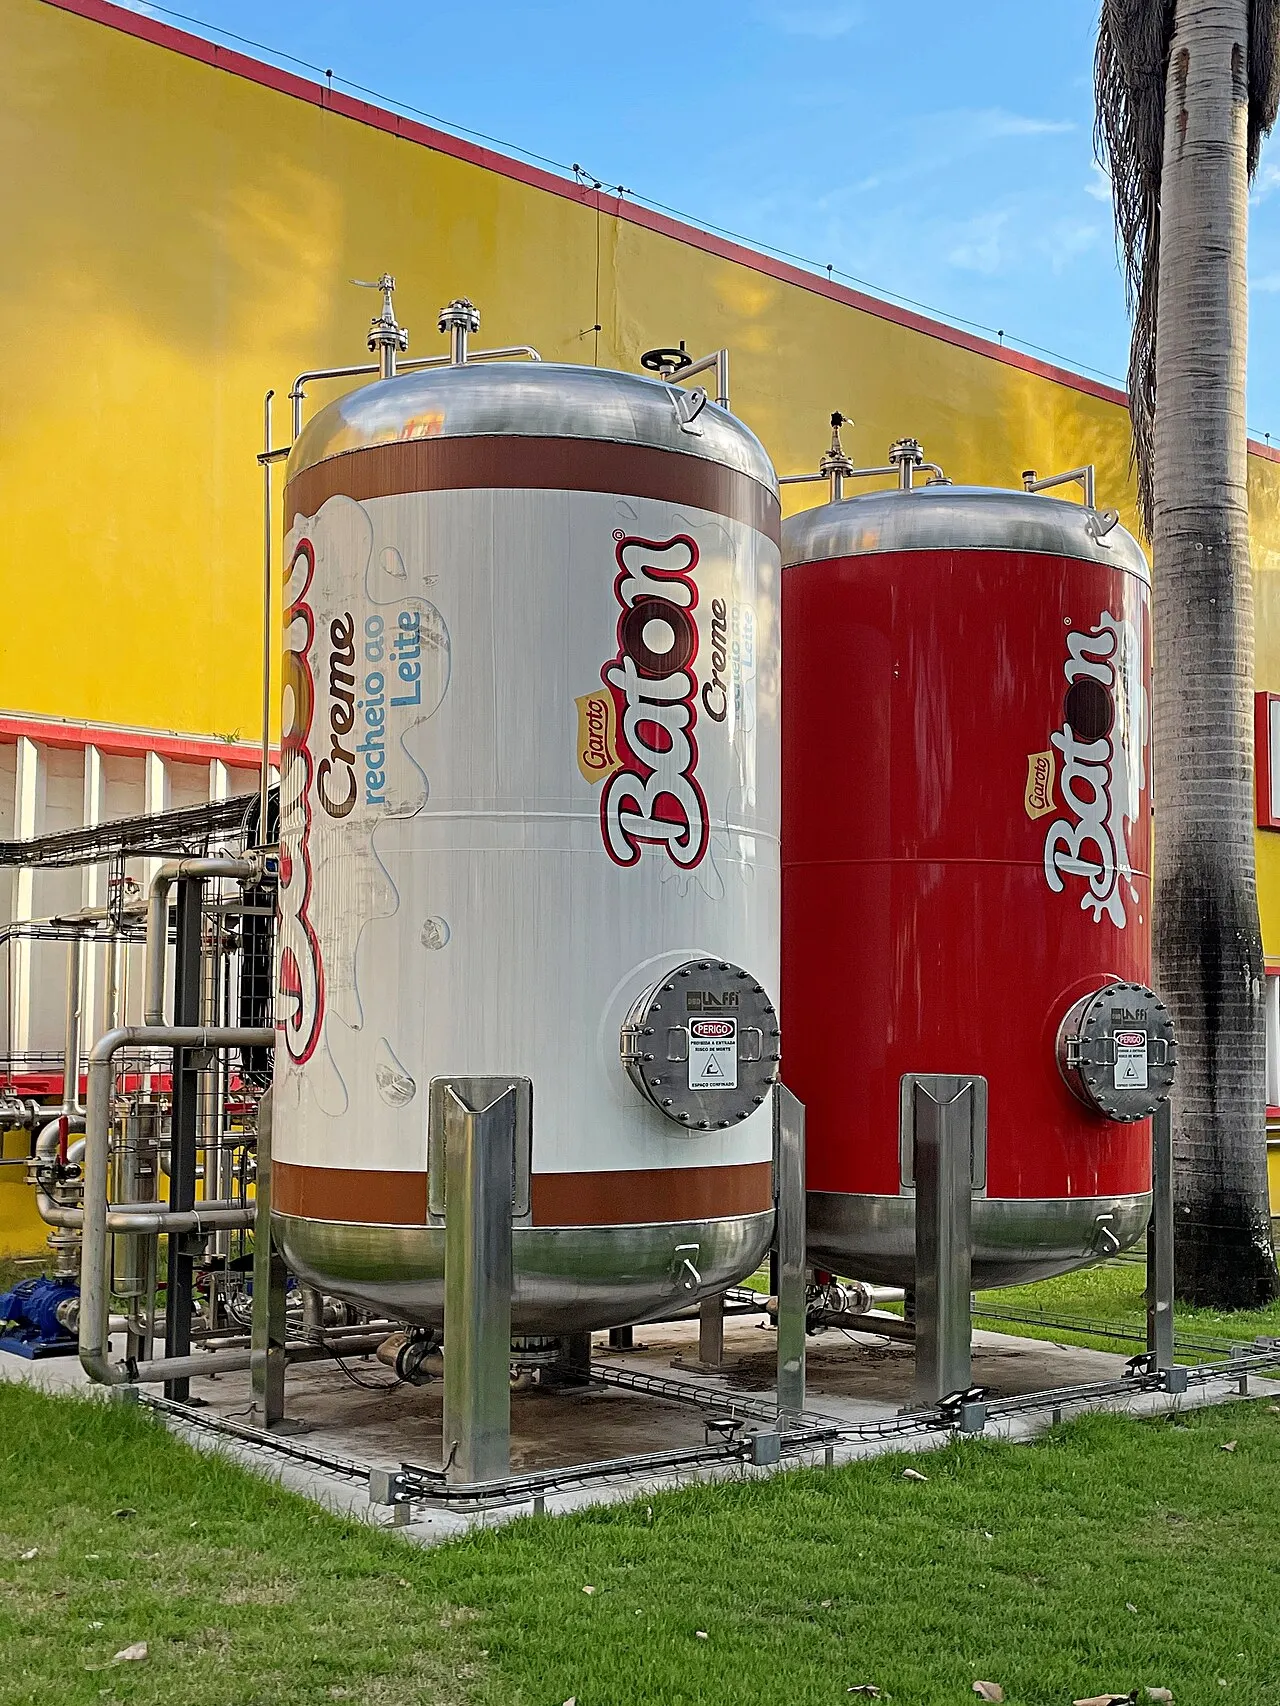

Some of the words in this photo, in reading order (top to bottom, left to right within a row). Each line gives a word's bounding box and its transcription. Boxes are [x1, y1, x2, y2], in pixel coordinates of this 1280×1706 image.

[364, 614, 385, 662] ao
[390, 611, 422, 707] Leite
[702, 598, 727, 722] Creme
[317, 611, 357, 818] Creme
[357, 671, 386, 805] recheio
[583, 699, 608, 769] Garoto
[603, 534, 708, 868] Baton
[1029, 758, 1047, 809] Garoto
[1043, 629, 1116, 899] Baton
[698, 1024, 728, 1035] PERIGO
[1119, 1035, 1141, 1044] PERIGO
